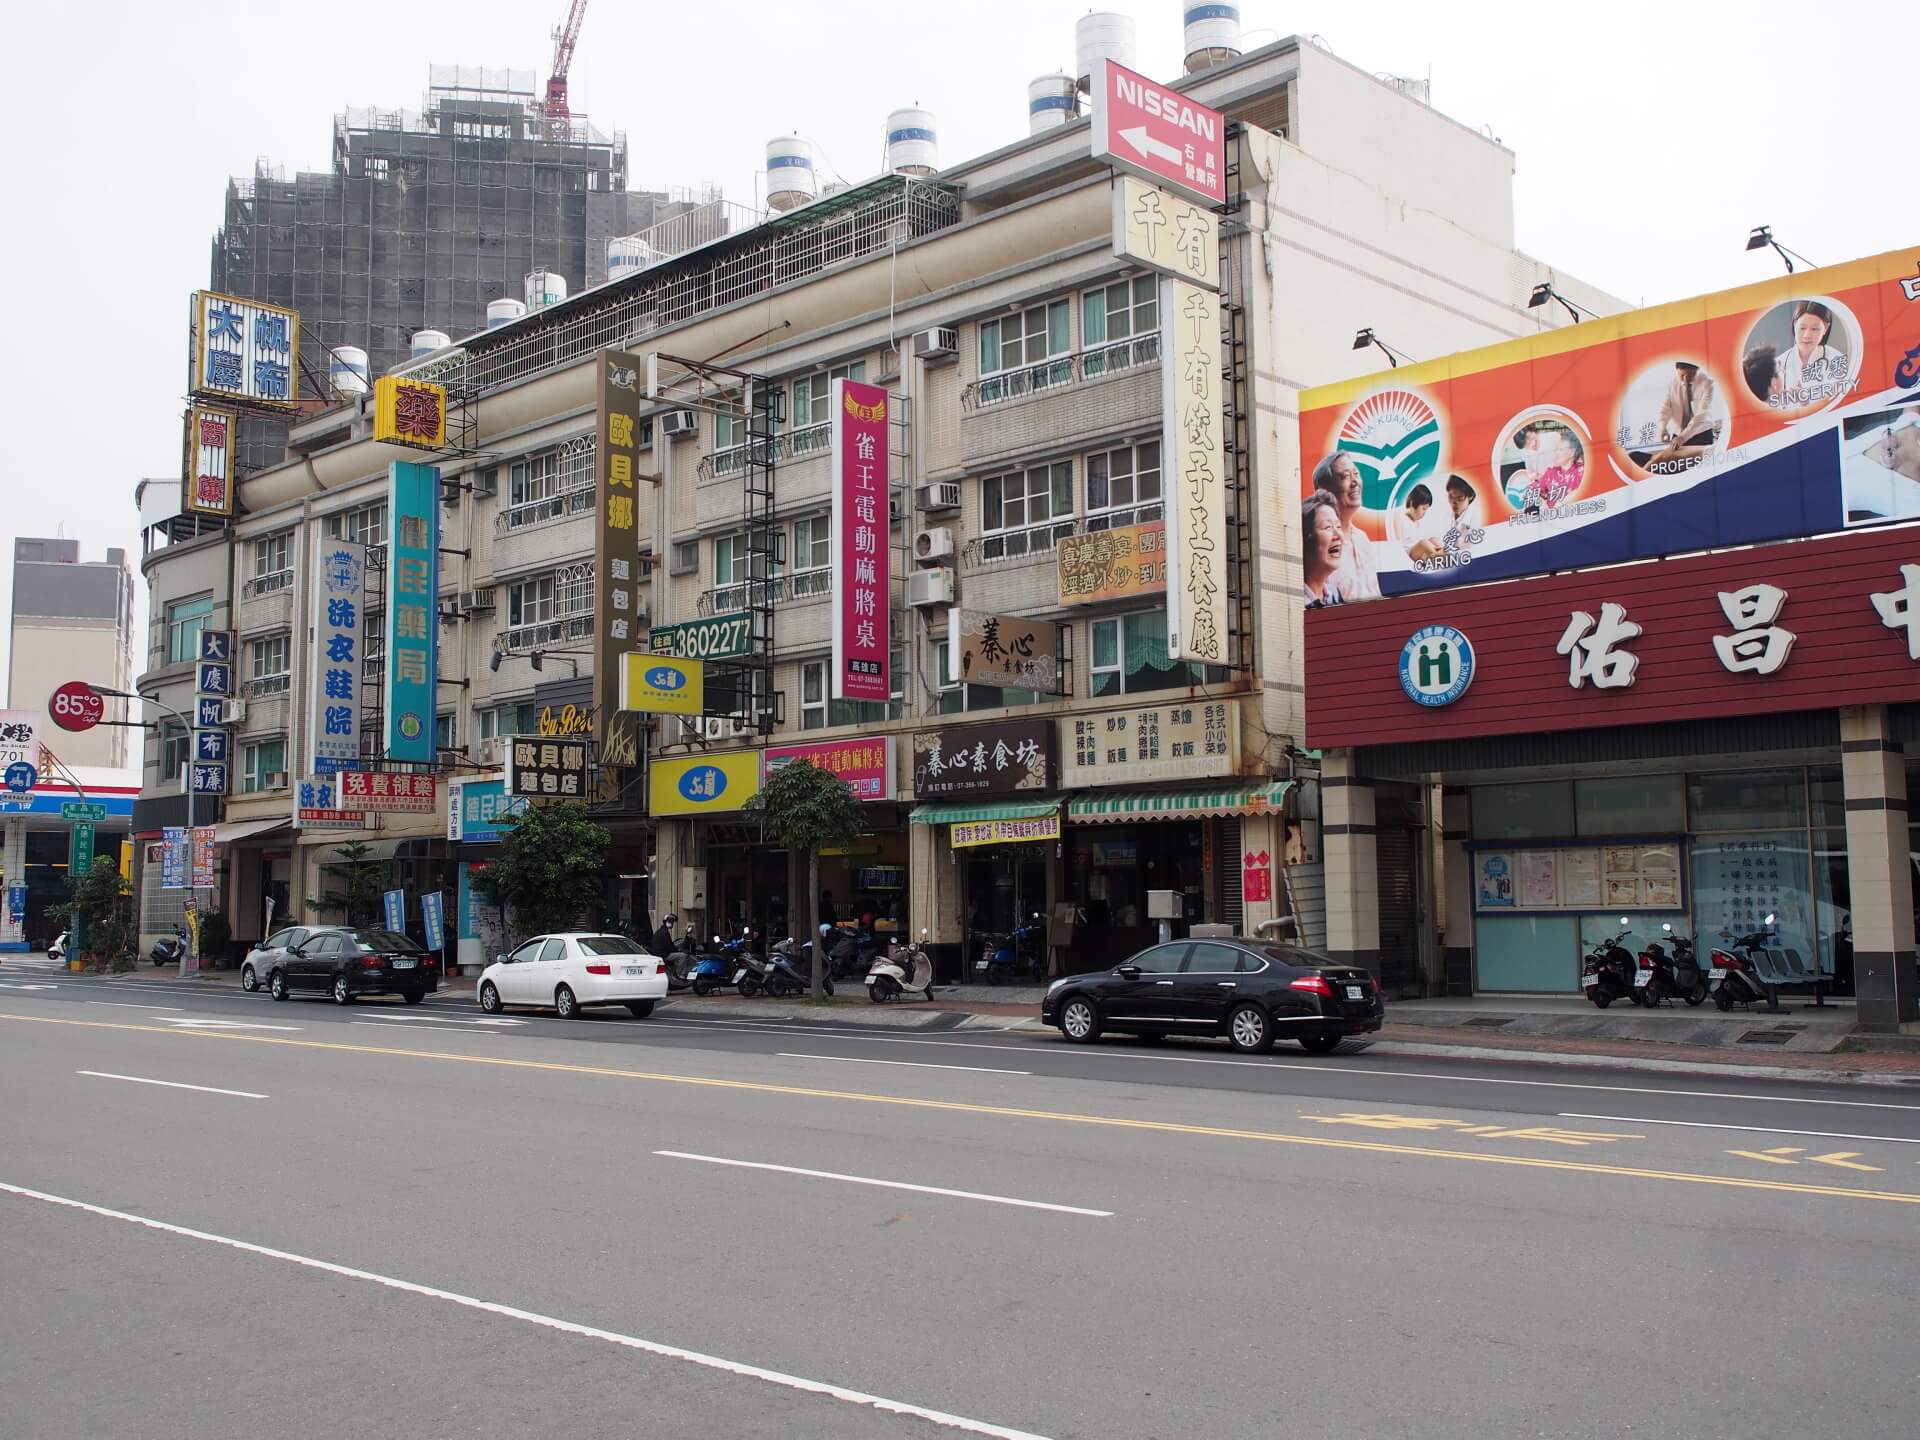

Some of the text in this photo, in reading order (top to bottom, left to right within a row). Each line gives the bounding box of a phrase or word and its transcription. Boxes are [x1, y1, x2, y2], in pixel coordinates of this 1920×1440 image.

[1116, 74, 1215, 142] NISSAN
[1133, 191, 1209, 277] 千有
[1801, 353, 1848, 383] 誠懇
[1769, 378, 1860, 407] SINCERITY
[1377, 415, 1414, 431] KUANG
[608, 412, 634, 529] 歐貝娜
[1509, 499, 1607, 526] FRIENDLINESS
[1522, 485, 1568, 509] 親切
[855, 432, 876, 648] 雀王電動麻將桌
[1442, 528, 1485, 552] 愛心
[1414, 552, 1471, 573] CARING
[611, 558, 630, 639] 麵包店
[676, 619, 751, 657] 3602277
[325, 598, 355, 736] 洗衣鞋院
[1400, 663, 1470, 704] NATIONAL HEALTH INSURANCE
[55, 694, 99, 715] 85°C
[1086, 720, 1096, 765] 牛肉麵
[1204, 706, 1216, 755] 各式小菜
[1216, 704, 1227, 754] 各式小炒
[515, 743, 583, 770] 歐貝娜
[347, 773, 433, 796] 免費領藥
[520, 772, 578, 794] 麵包店
